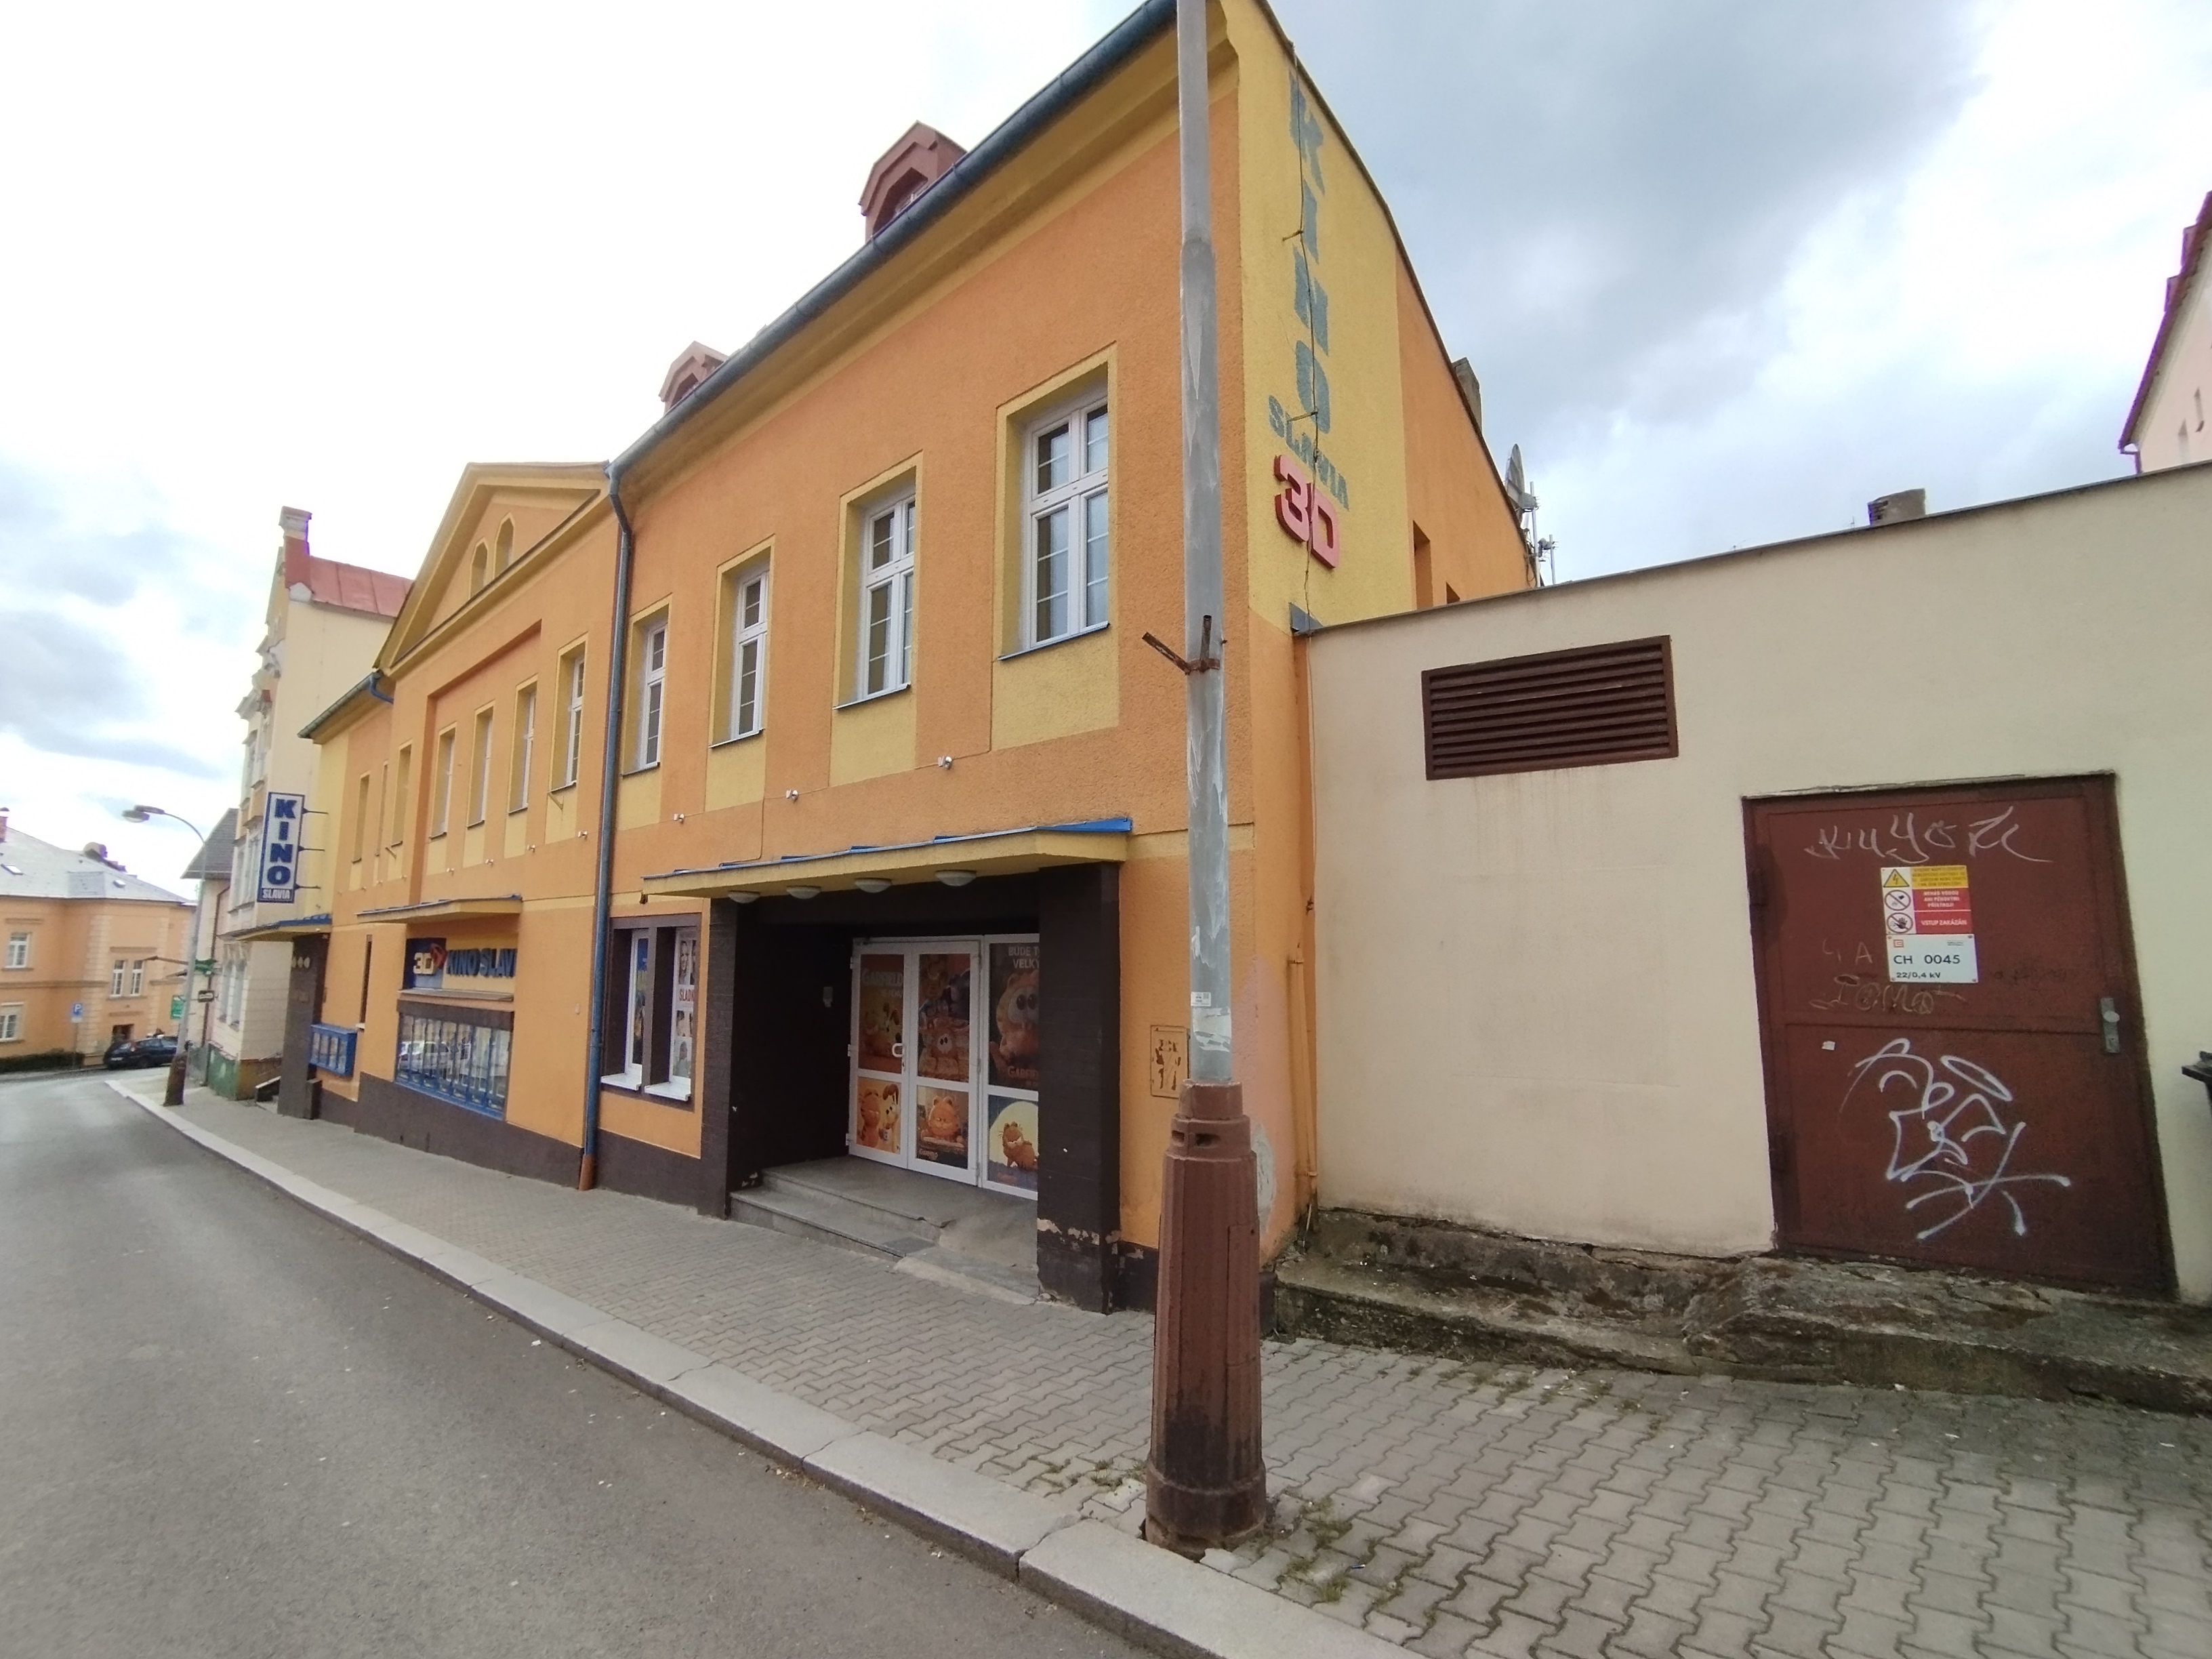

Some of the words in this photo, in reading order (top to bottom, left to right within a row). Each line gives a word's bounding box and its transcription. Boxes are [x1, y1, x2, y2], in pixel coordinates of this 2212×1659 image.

[1290, 73, 1331, 435] KINO
[1268, 393, 1349, 512] SLAVIA
[1273, 453, 1340, 569] 3D
[267, 798, 298, 886] KINO
[262, 888, 291, 899] SLAVIA
[412, 951, 434, 975] 3D
[446, 949, 480, 977] KINO
[1008, 946, 1031, 956] BUDE
[1893, 955, 1913, 964] CH
[1924, 954, 1961, 964] 0045
